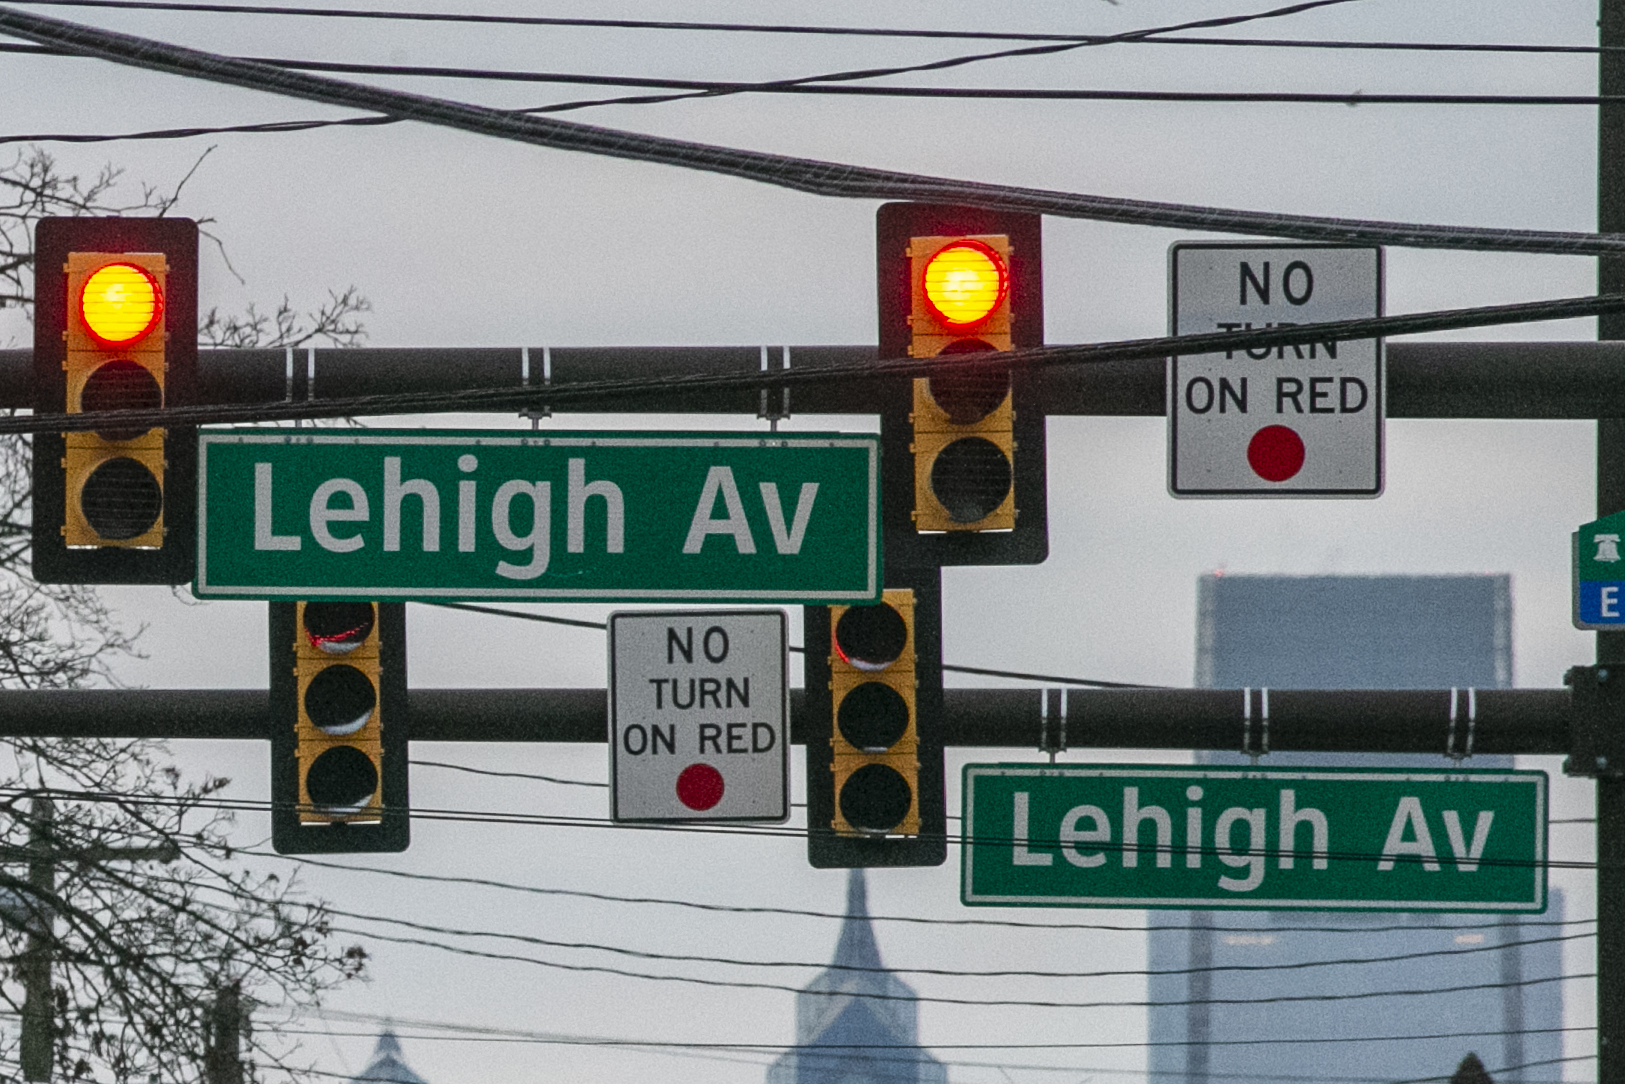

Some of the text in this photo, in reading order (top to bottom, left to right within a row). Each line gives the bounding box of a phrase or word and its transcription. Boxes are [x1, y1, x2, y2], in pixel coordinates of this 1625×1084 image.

[1239, 260, 1314, 306] NO
[1185, 376, 1369, 414] ON RED
[254, 454, 820, 580] Lehigh Av
[666, 626, 730, 664] NO
[649, 677, 750, 709] TURN
[623, 722, 776, 756] ON RED
[1012, 786, 1495, 892] Lehigh Av
